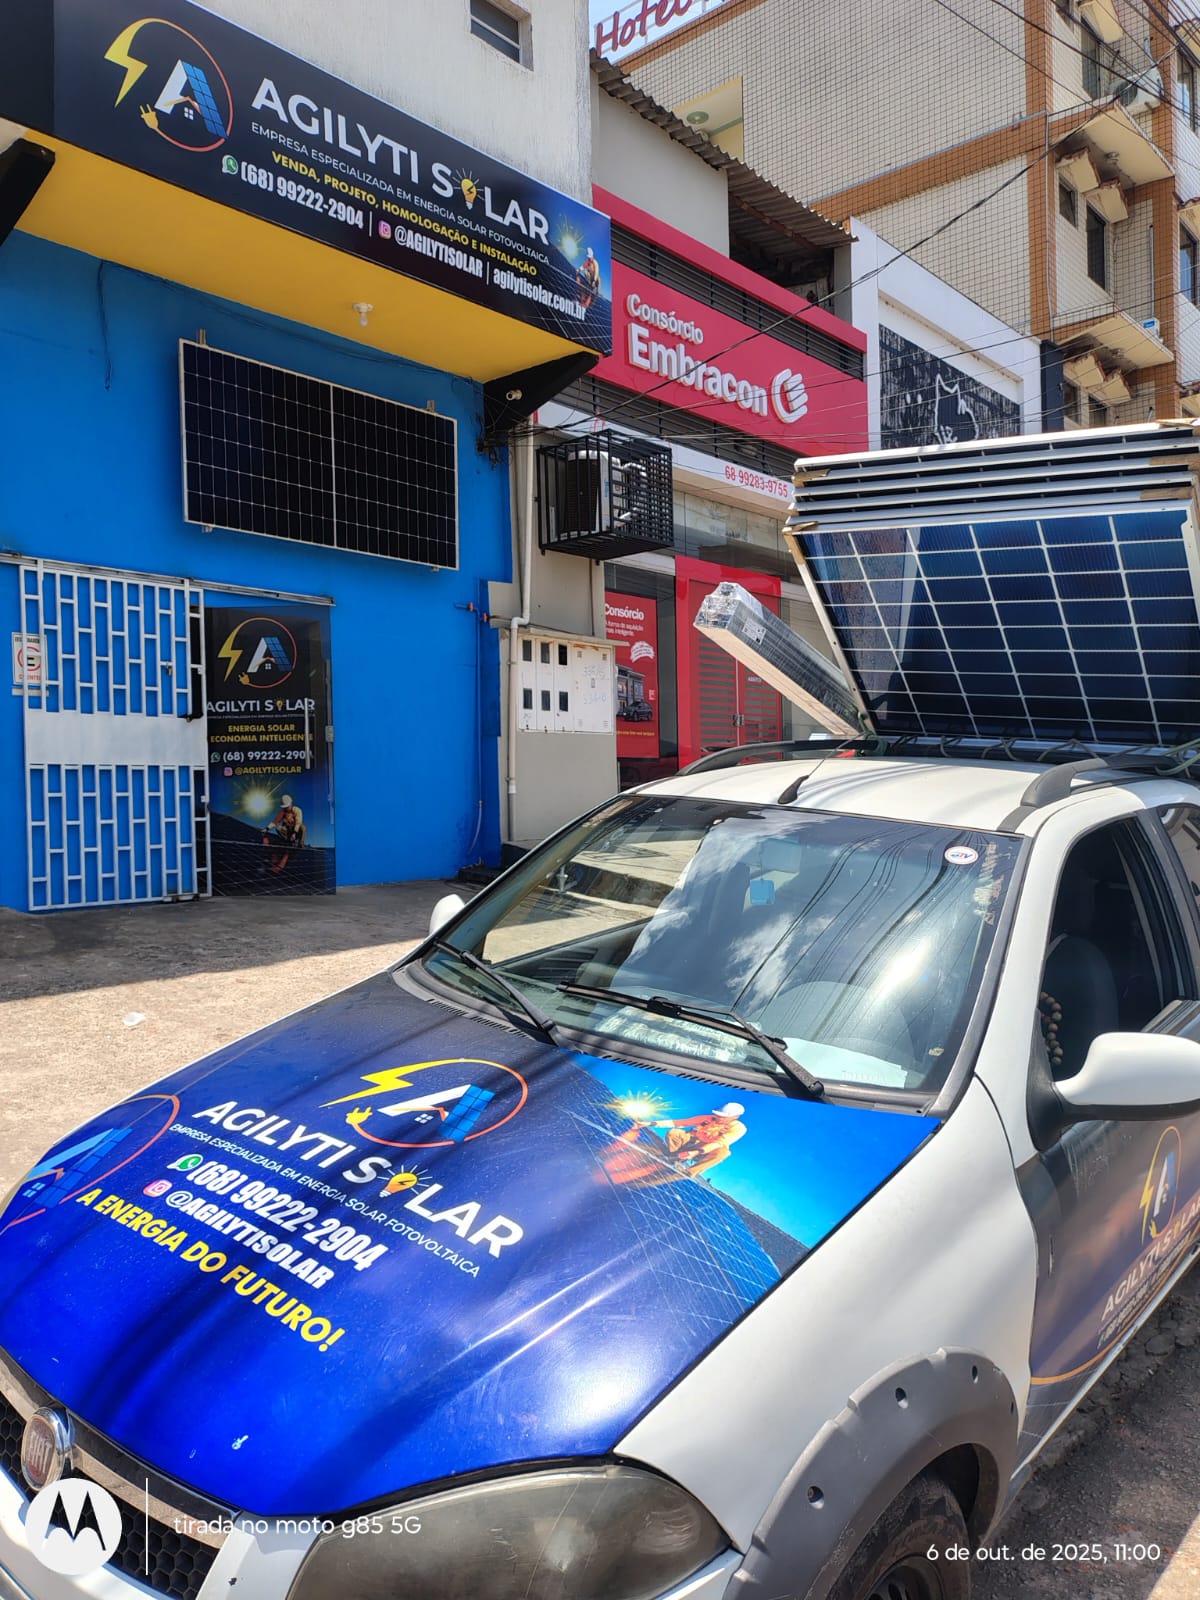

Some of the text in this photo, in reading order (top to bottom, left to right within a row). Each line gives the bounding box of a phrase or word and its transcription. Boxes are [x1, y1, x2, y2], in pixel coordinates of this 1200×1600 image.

[251, 77, 419, 184] AGILYTI
[251, 122, 549, 265] EMPRESA ESPECIALIZADA EM ENERGIA SOLAR FOTOVOLTAICA
[271, 150, 537, 276] VENDA, PROJETO, HOMOLOGAÇÃO E INSTALAÇÃO
[240, 161, 587, 321] (68) 99222-2904 @AGILYTISOLAR agilytisolar.com.br
[627, 293, 704, 345] Consórcio
[628, 322, 768, 417] Embracon
[724, 464, 737, 481] 68
[207, 699, 260, 713] AGILYTI
[210, 733, 313, 743] ECONOMIA INTELIGENE
[227, 724, 295, 733] ENERGIA SOLAR
[222, 751, 244, 763] (68)
[235, 766, 302, 776] @AGILYTISOLAR
[191, 1101, 356, 1168] AGILYTI
[166, 1190, 335, 1289] @AGILYTISOLAR
[169, 1123, 481, 1278] EMPRESA ESPECIALIZADA EM ENERGIA SOLAR FOTOVOLTAICA
[186, 1160, 389, 1272] (68) 99222-2904
[77, 1188, 346, 1352] A ENERGIA DO FUTURO!
[1101, 1241, 1160, 1321] AGILYTI
